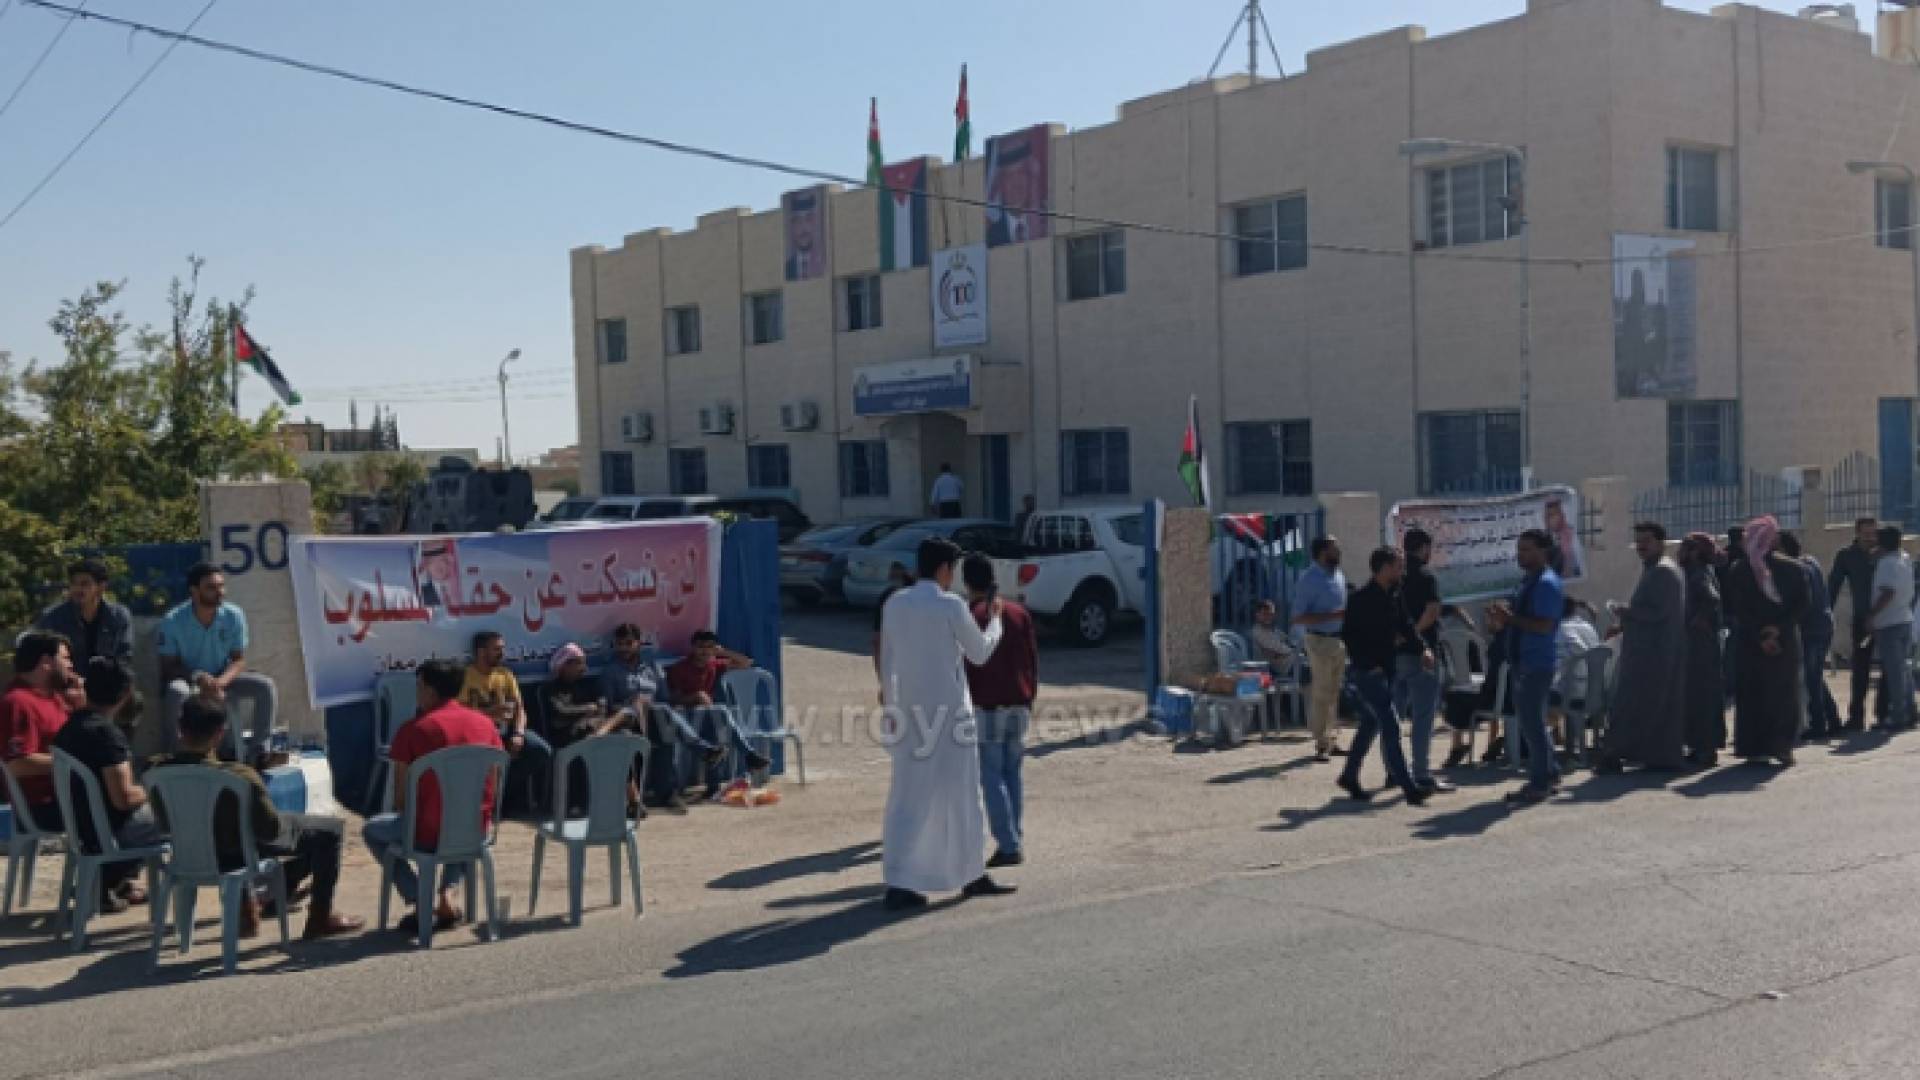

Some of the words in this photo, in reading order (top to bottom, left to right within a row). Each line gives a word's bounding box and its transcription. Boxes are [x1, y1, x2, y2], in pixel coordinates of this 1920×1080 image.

[220, 520, 289, 574] 50
[523, 569, 566, 632] عن
[576, 551, 657, 605] نسكت
[667, 548, 695, 616] لن
